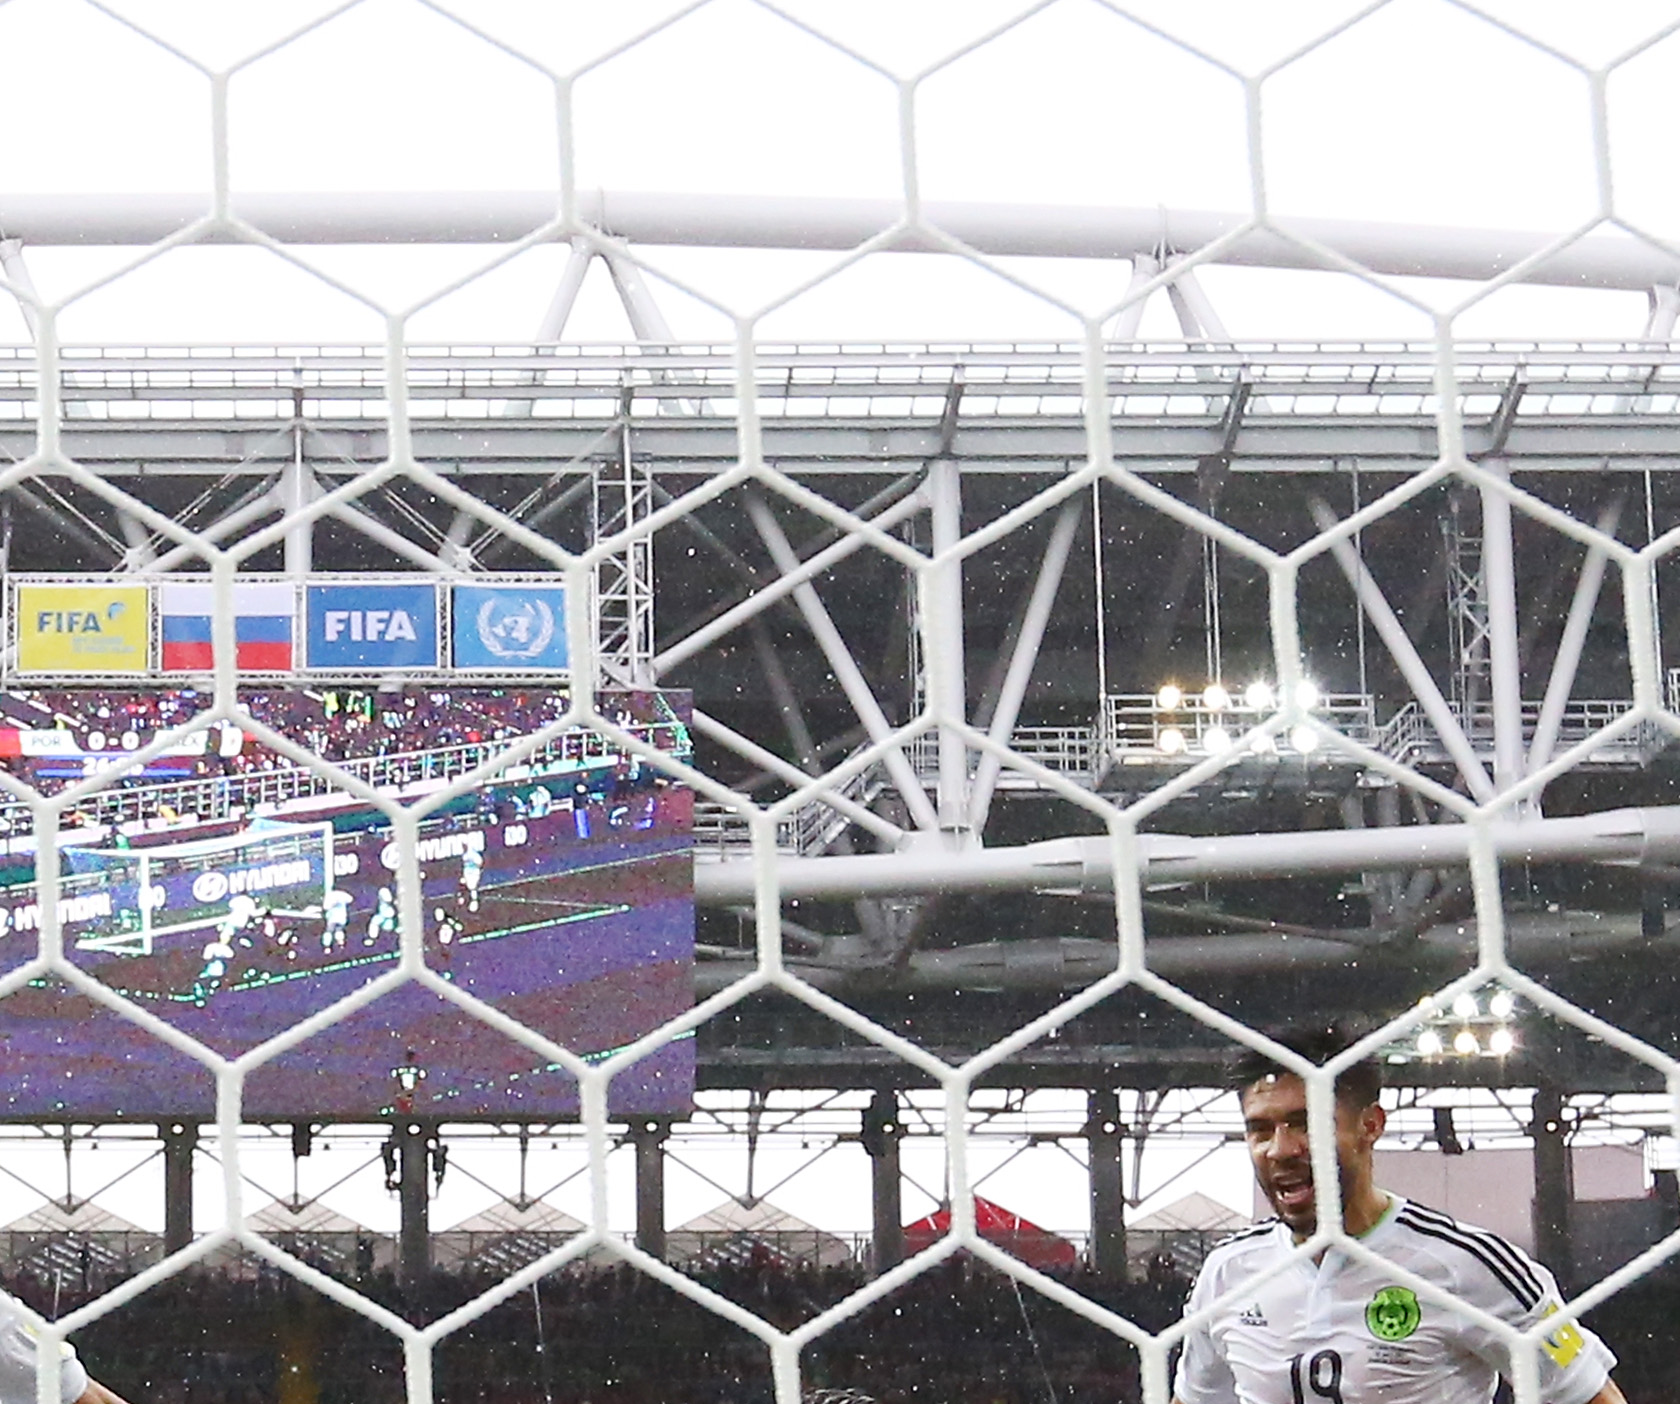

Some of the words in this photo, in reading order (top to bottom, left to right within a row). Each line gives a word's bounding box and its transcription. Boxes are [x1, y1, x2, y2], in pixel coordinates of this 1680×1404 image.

[37, 611, 102, 633] FIFA
[324, 610, 417, 641] FIFA
[31, 736, 61, 747] POR
[228, 860, 311, 895] HYUNDAI
[14, 892, 112, 931] HYNDAI
